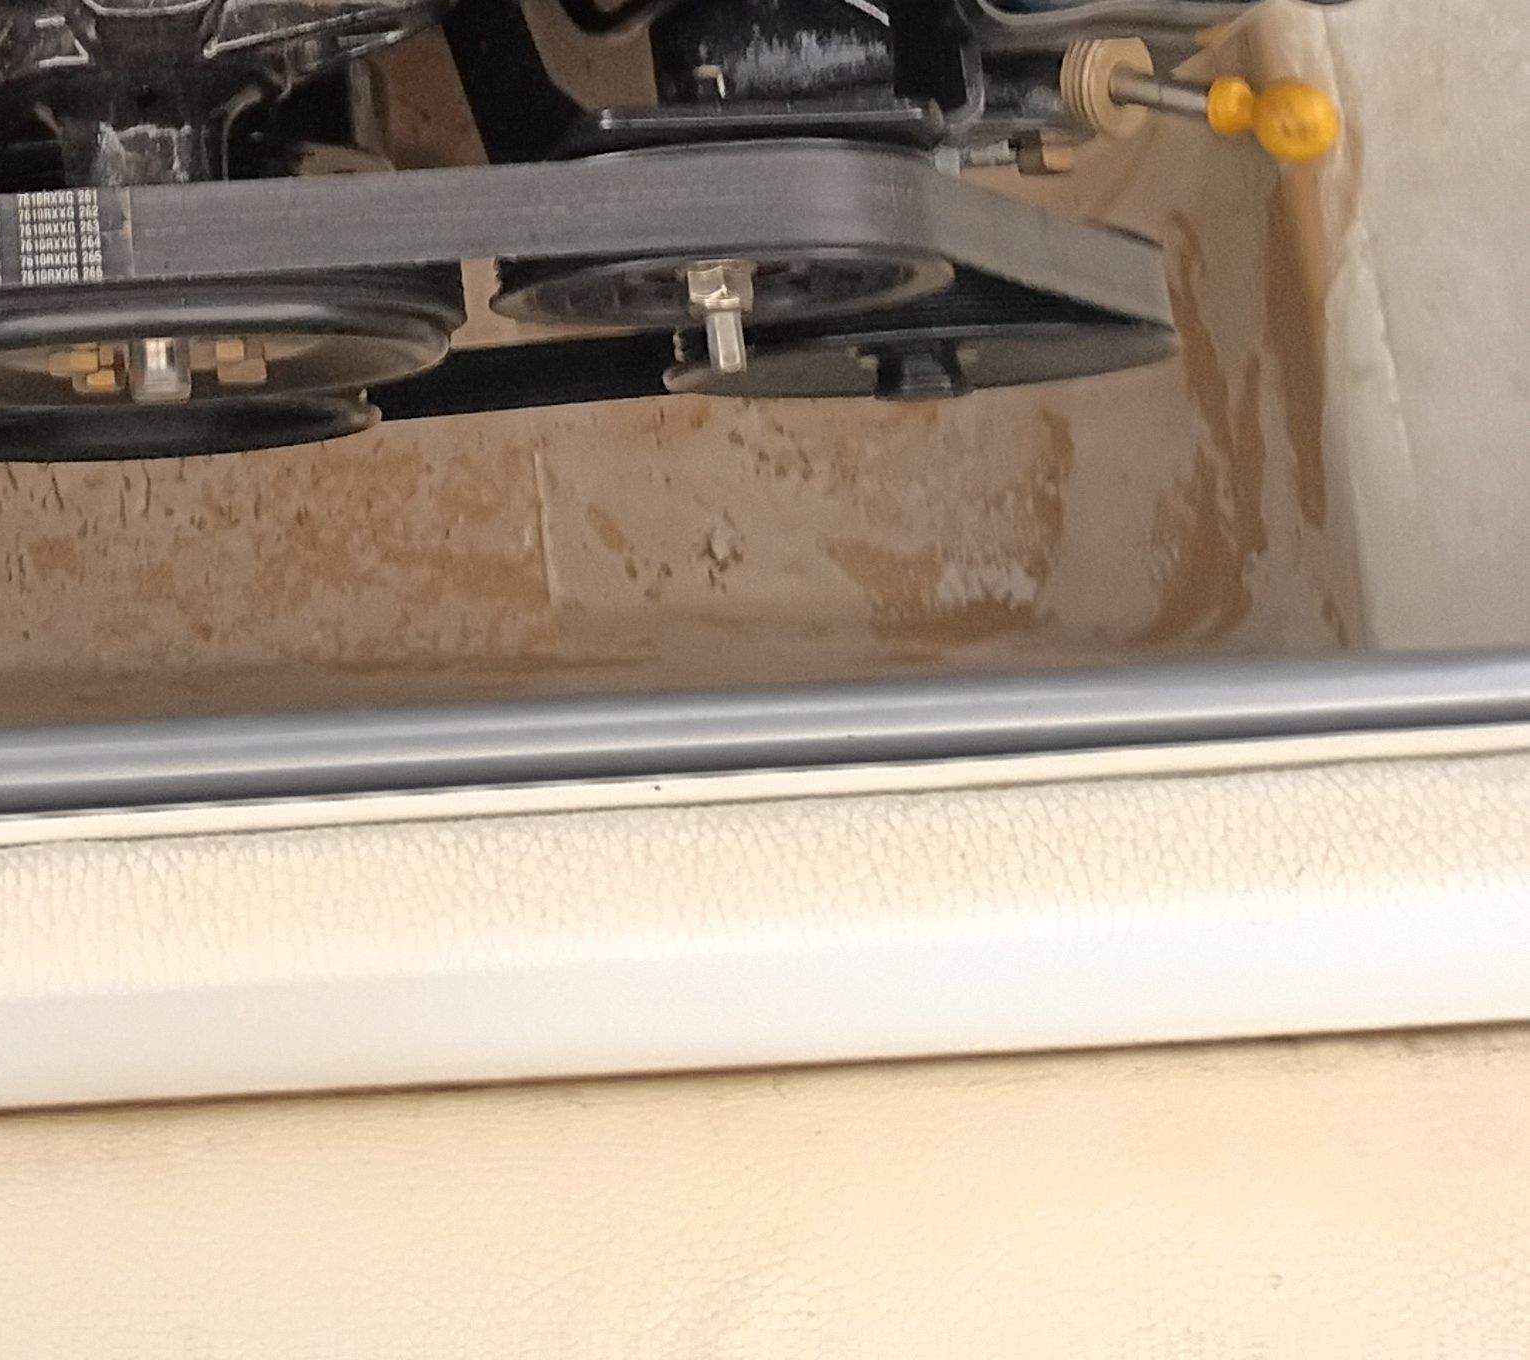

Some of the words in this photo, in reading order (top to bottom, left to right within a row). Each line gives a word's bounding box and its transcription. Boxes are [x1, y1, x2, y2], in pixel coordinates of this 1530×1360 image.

[77, 189, 97, 204] 261
[78, 205, 98, 218] 262
[79, 220, 99, 233] 263
[80, 235, 100, 249] 264
[81, 250, 102, 264] 265
